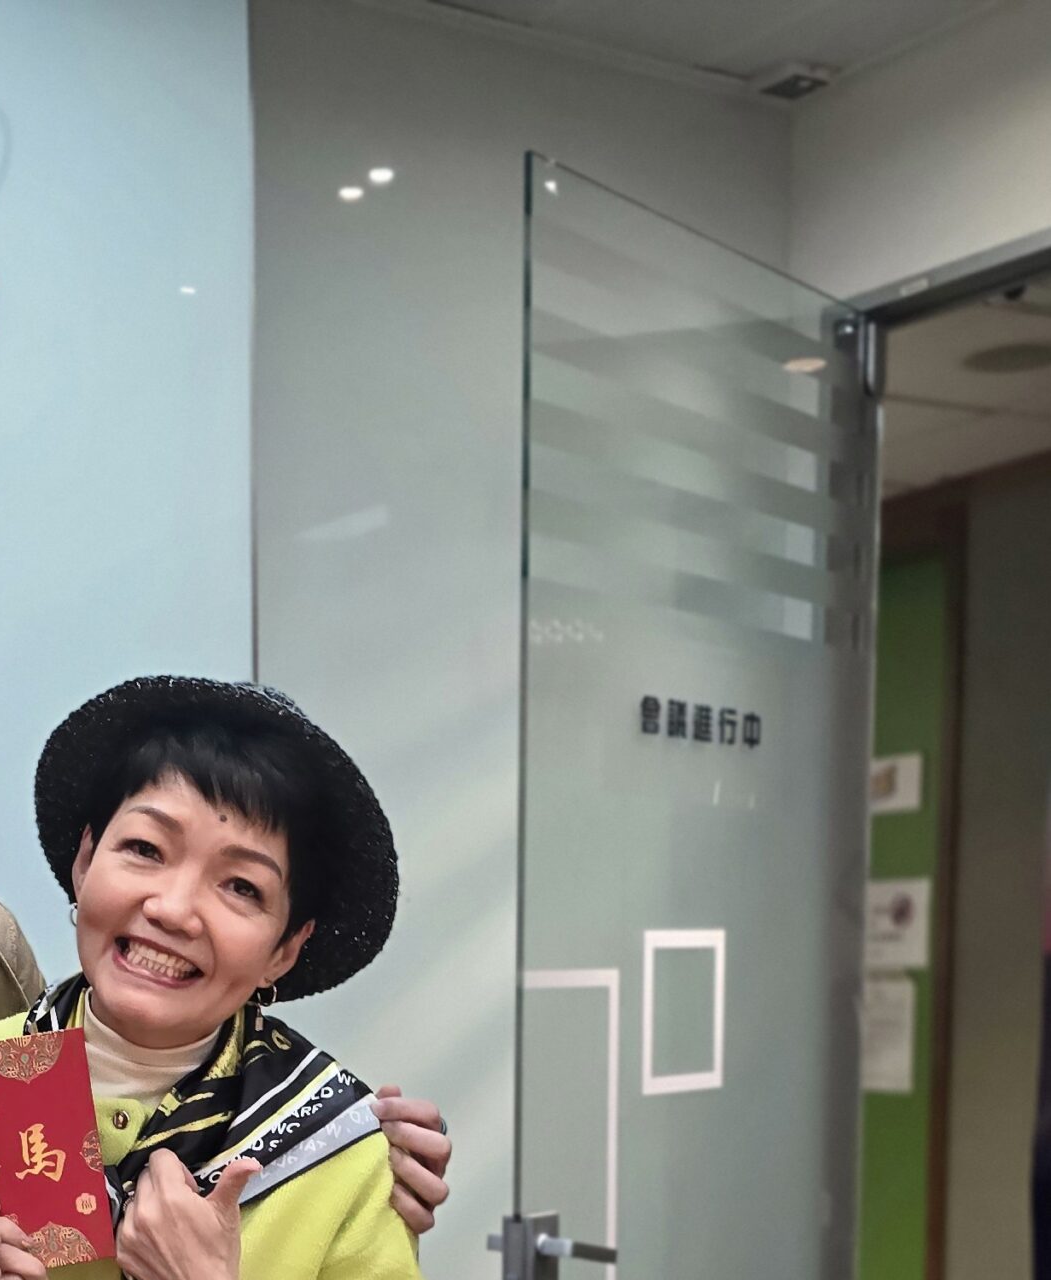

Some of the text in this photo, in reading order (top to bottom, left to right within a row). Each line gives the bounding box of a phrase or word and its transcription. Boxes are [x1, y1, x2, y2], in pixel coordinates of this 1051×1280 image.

[641, 696, 761, 748] 會議進行中
[15, 1123, 66, 1182] 馬
